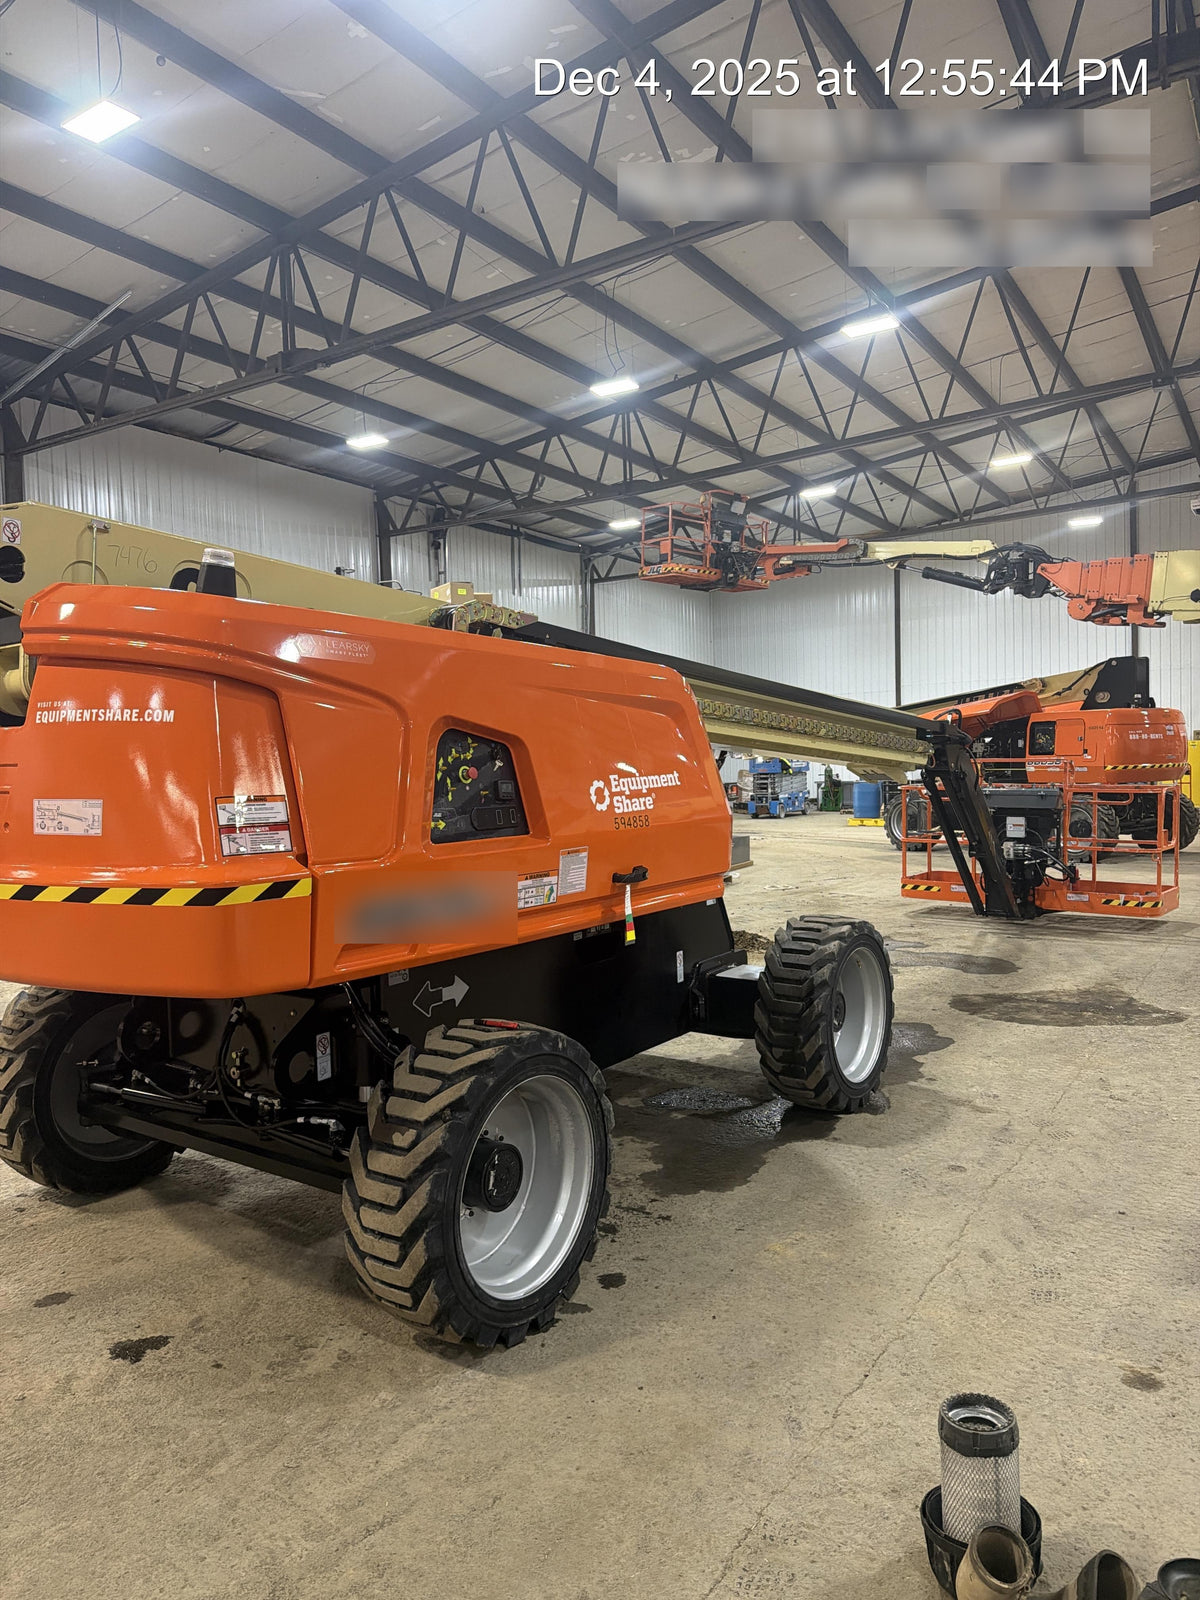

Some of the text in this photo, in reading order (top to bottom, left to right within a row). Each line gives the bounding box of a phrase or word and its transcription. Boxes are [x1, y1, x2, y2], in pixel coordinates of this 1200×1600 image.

[106, 544, 158, 574] 7476
[53, 700, 62, 708] US
[35, 709, 175, 724] EQUIPMENTSHARE.COM
[609, 770, 681, 795] Equipment
[614, 815, 650, 830] 594858
[529, 871, 551, 880] WARNING
